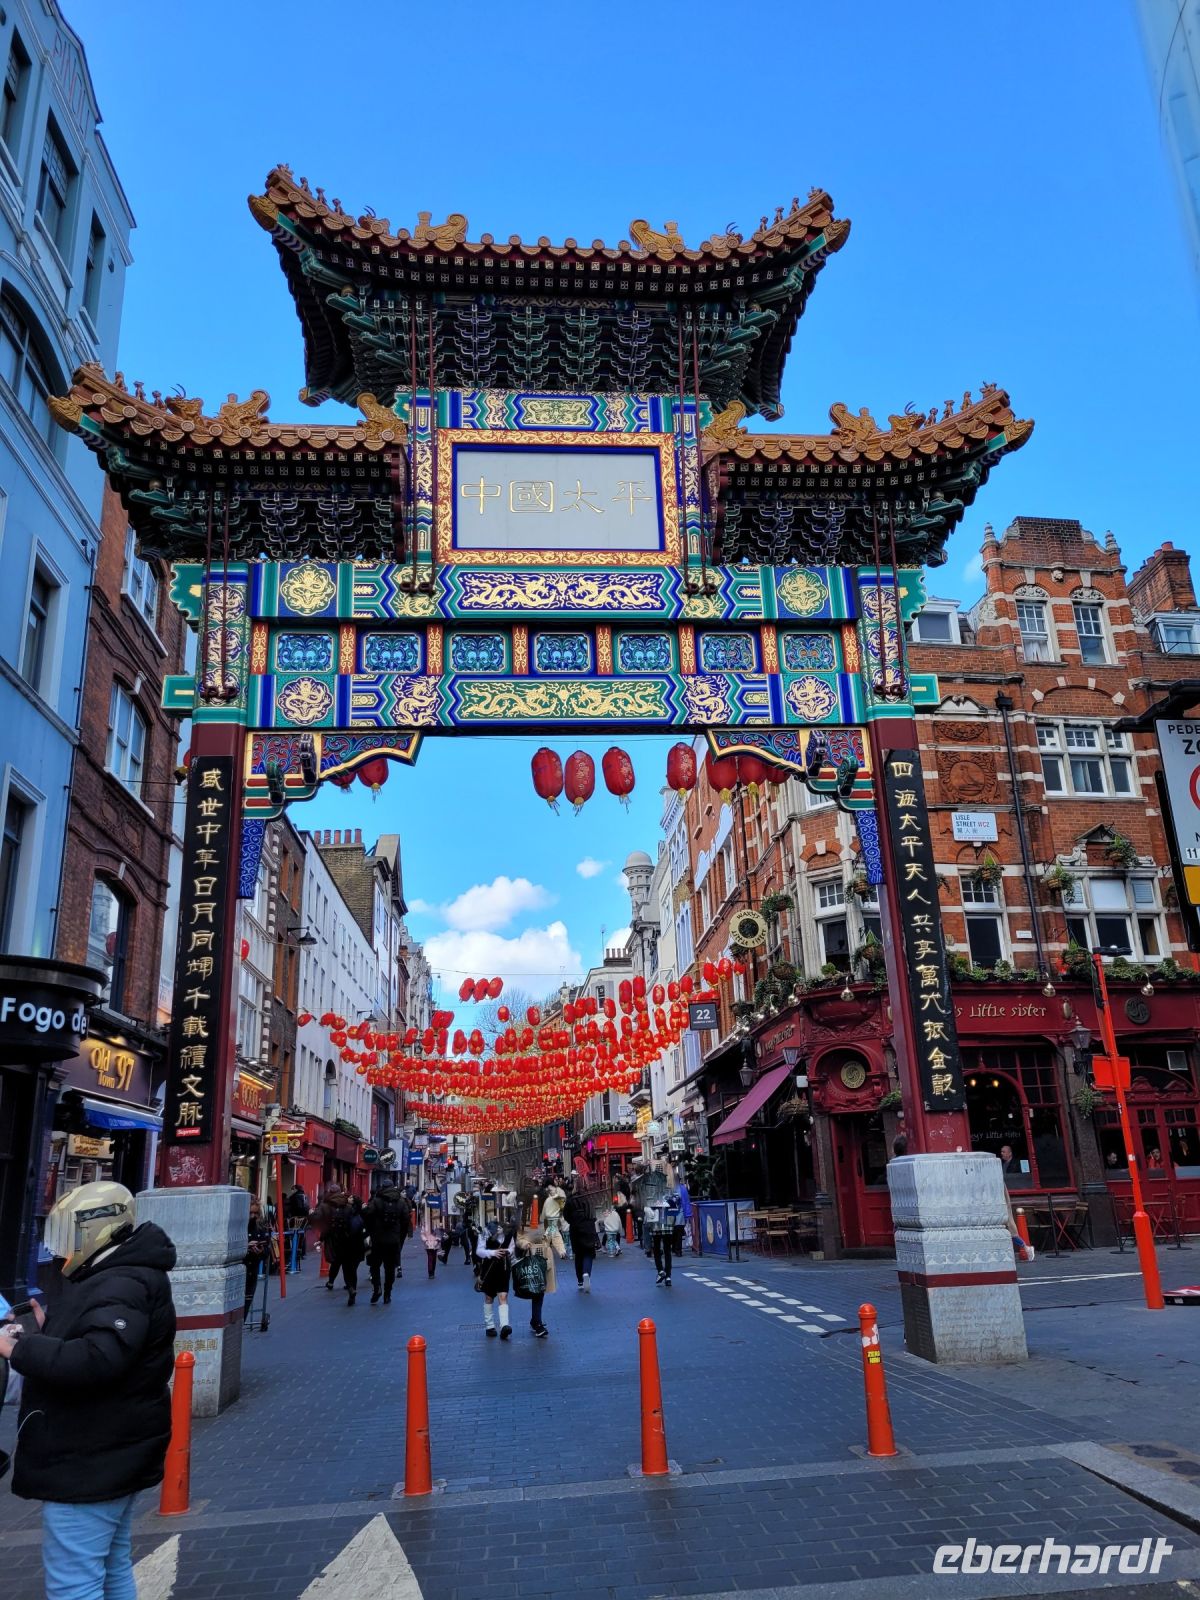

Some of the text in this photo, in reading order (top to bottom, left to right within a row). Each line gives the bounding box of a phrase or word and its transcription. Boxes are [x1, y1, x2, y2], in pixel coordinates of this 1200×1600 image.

[461, 476, 653, 516] 中國太平
[1, 997, 87, 1035] Fogo de
[696, 1009, 711, 1020] 22
[90, 1047, 111, 1072] Old
[97, 1070, 116, 1089] Town
